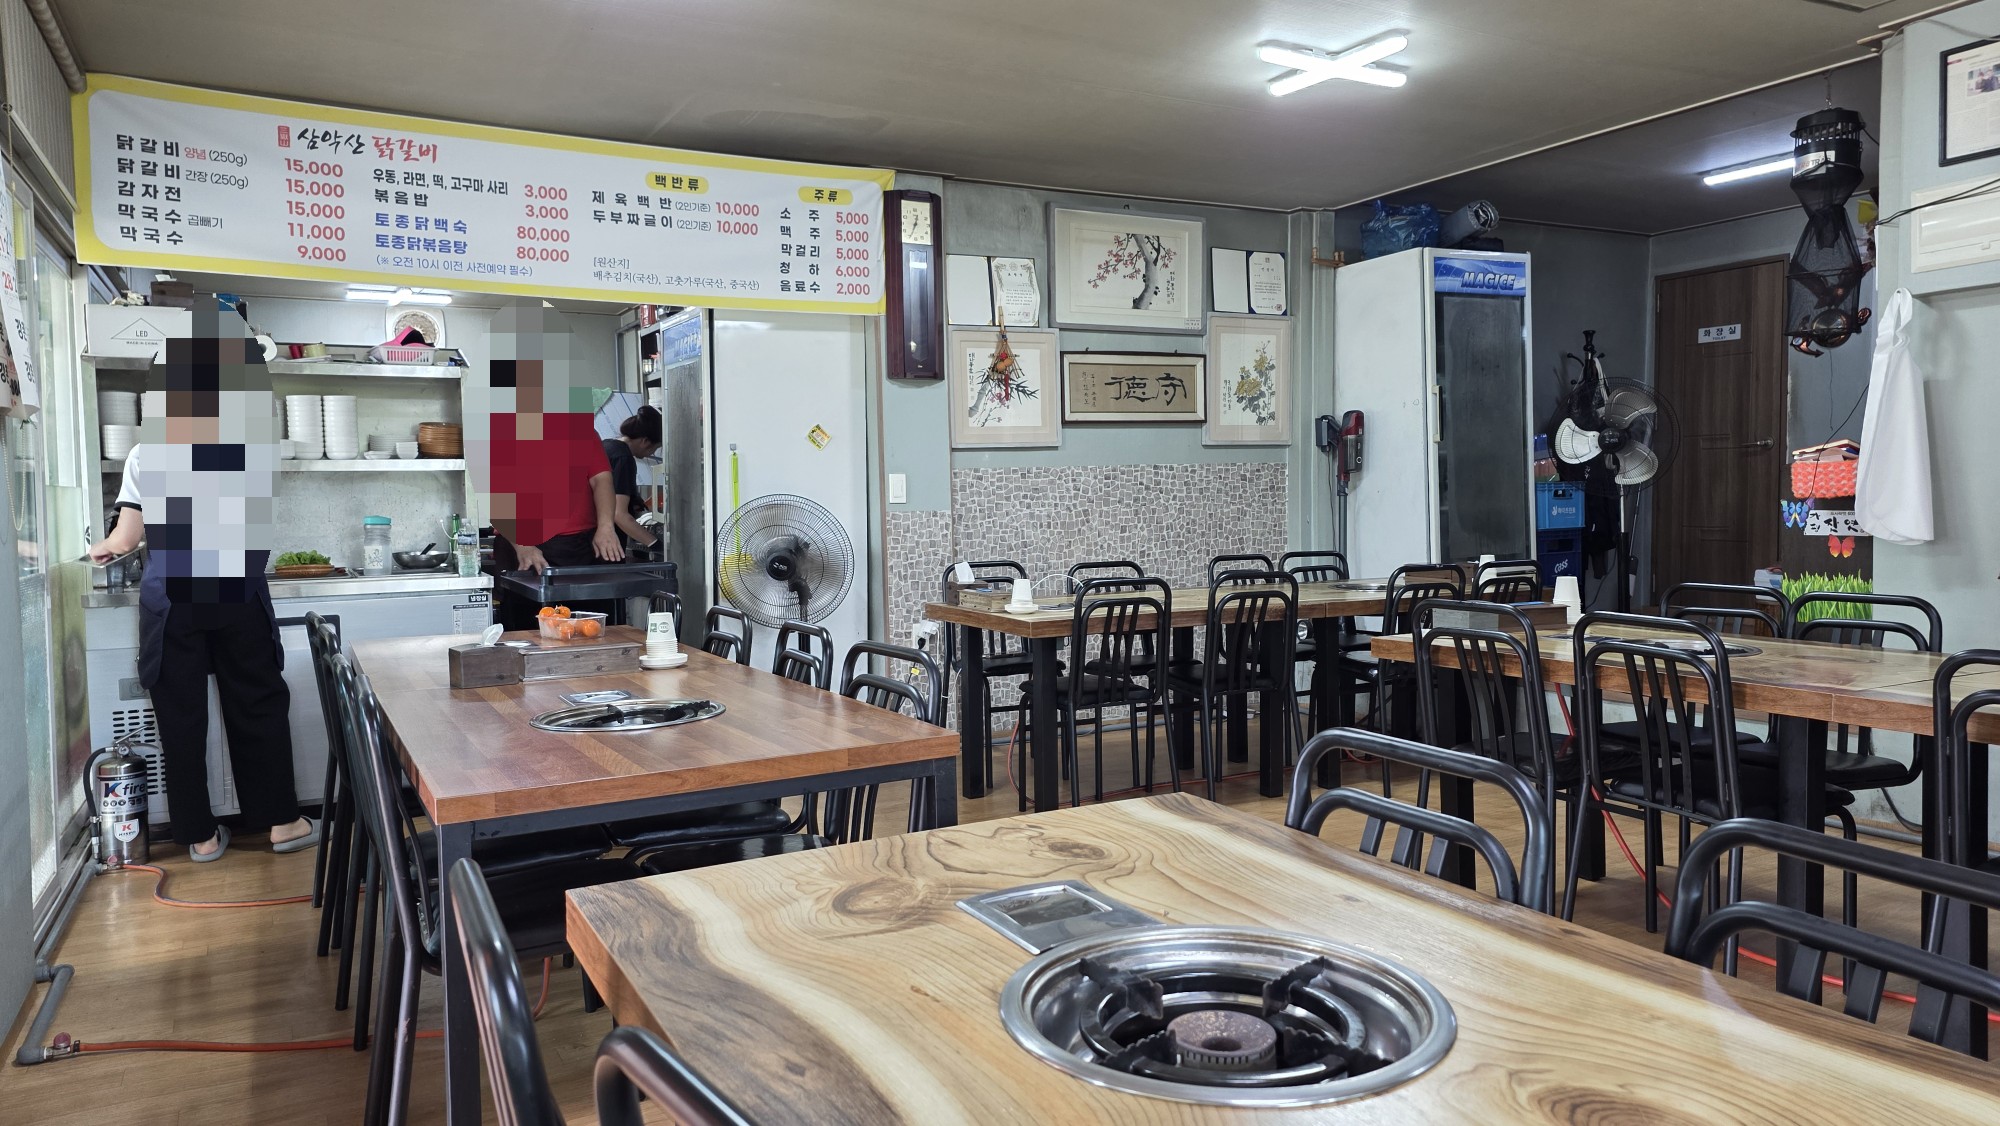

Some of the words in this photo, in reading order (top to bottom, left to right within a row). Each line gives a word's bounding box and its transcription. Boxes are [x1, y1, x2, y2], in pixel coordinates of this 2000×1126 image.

[297, 128, 366, 154] 삼악산
[372, 136, 438, 164] 닭갈비
[184, 146, 206, 160] 양념
[208, 149, 248, 167] (250g)
[284, 158, 343, 178] 15,000
[185, 169, 208, 183] 간장
[210, 172, 249, 190] (250g)
[373, 168, 399, 185] 우동,
[403, 171, 429, 188] 라면,
[432, 174, 447, 190] 떡,
[450, 176, 484, 193] 고구마
[487, 179, 508, 195] 사리
[285, 178, 344, 198] 15,000
[524, 184, 567, 201] 3,000
[814, 189, 838, 202] 주류
[286, 200, 345, 219] 15,000
[525, 204, 569, 220] 3,000
[675, 201, 711, 213] (2인기준)
[715, 202, 760, 217] 10,000
[188, 214, 223, 229] 곱빼기
[836, 211, 869, 225] 5,000
[287, 222, 345, 241] 11,000
[517, 225, 570, 243] 80,000
[676, 219, 712, 232] (2인기준)
[716, 220, 758, 235] 10,000
[375, 233, 468, 255] 토종닭볶음탕
[835, 229, 869, 243] 5,000
[297, 245, 346, 262] 9,000
[516, 246, 570, 263] 80,000
[836, 247, 869, 261] 5,000
[392, 256, 414, 268] 오전
[417, 257, 439, 270] 10시
[443, 260, 463, 272] 이전
[466, 262, 506, 275] 사전예약
[509, 265, 533, 277] 필수)
[593, 257, 630, 269] [원산지]
[835, 265, 870, 278] 6,000
[729, 279, 760, 290] 중국산)
[836, 283, 871, 296] 2,000
[1461, 272, 1516, 291] MAGICE
[135, 330, 149, 338] LED
[1703, 326, 1736, 337] 화장실
[1554, 558, 1569, 574] Cass
